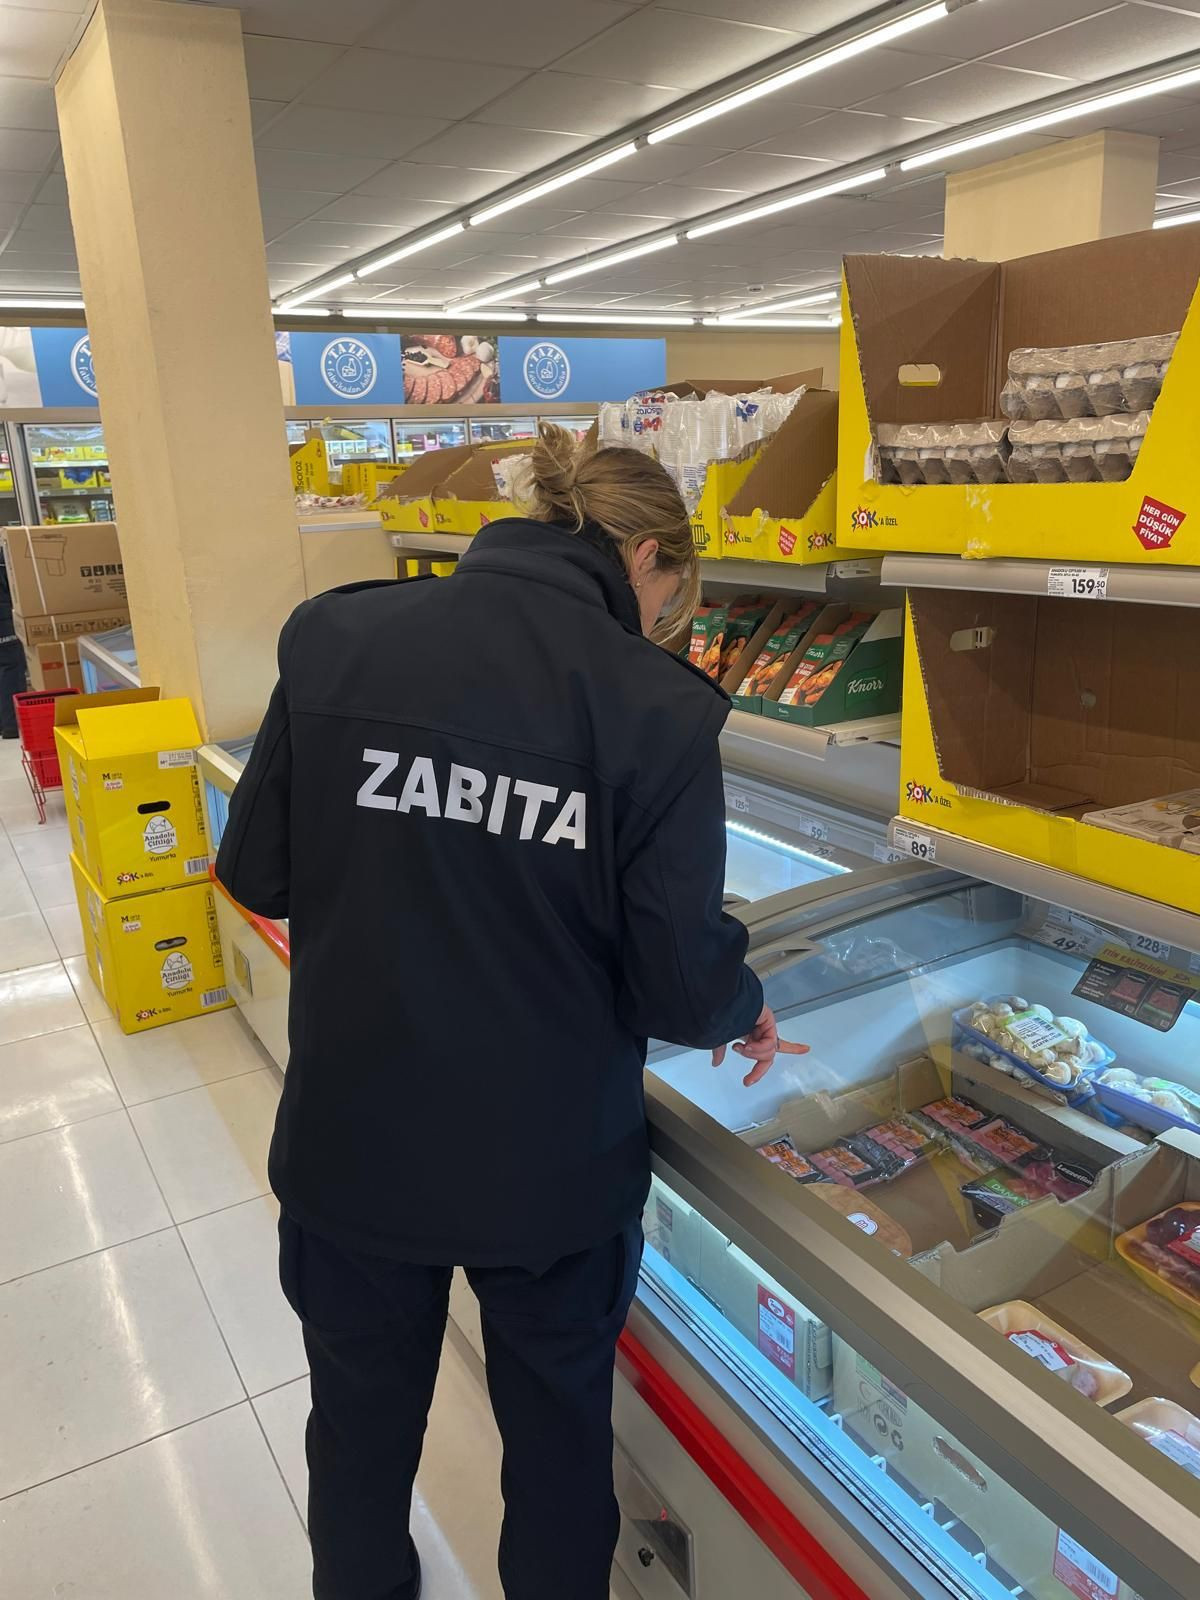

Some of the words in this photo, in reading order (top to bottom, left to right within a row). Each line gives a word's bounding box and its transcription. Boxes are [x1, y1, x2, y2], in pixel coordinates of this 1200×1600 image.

[327, 343, 367, 360] TAZE
[530, 347, 563, 363] TAZE
[1143, 503, 1161, 518] HER
[1161, 512, 1180, 527] GÜN
[1139, 514, 1174, 537] DÜŞÜK
[1139, 527, 1164, 544] FİYAT
[847, 678, 884, 695] Knorr
[356, 748, 586, 850] ZABITA
[144, 831, 176, 842] Anadolu
[811, 826, 822, 840] 59
[149, 852, 177, 863] Yumurta
[1136, 935, 1160, 953] 228
[162, 967, 192, 979] Anadolu
[167, 987, 193, 998] Yumurta
